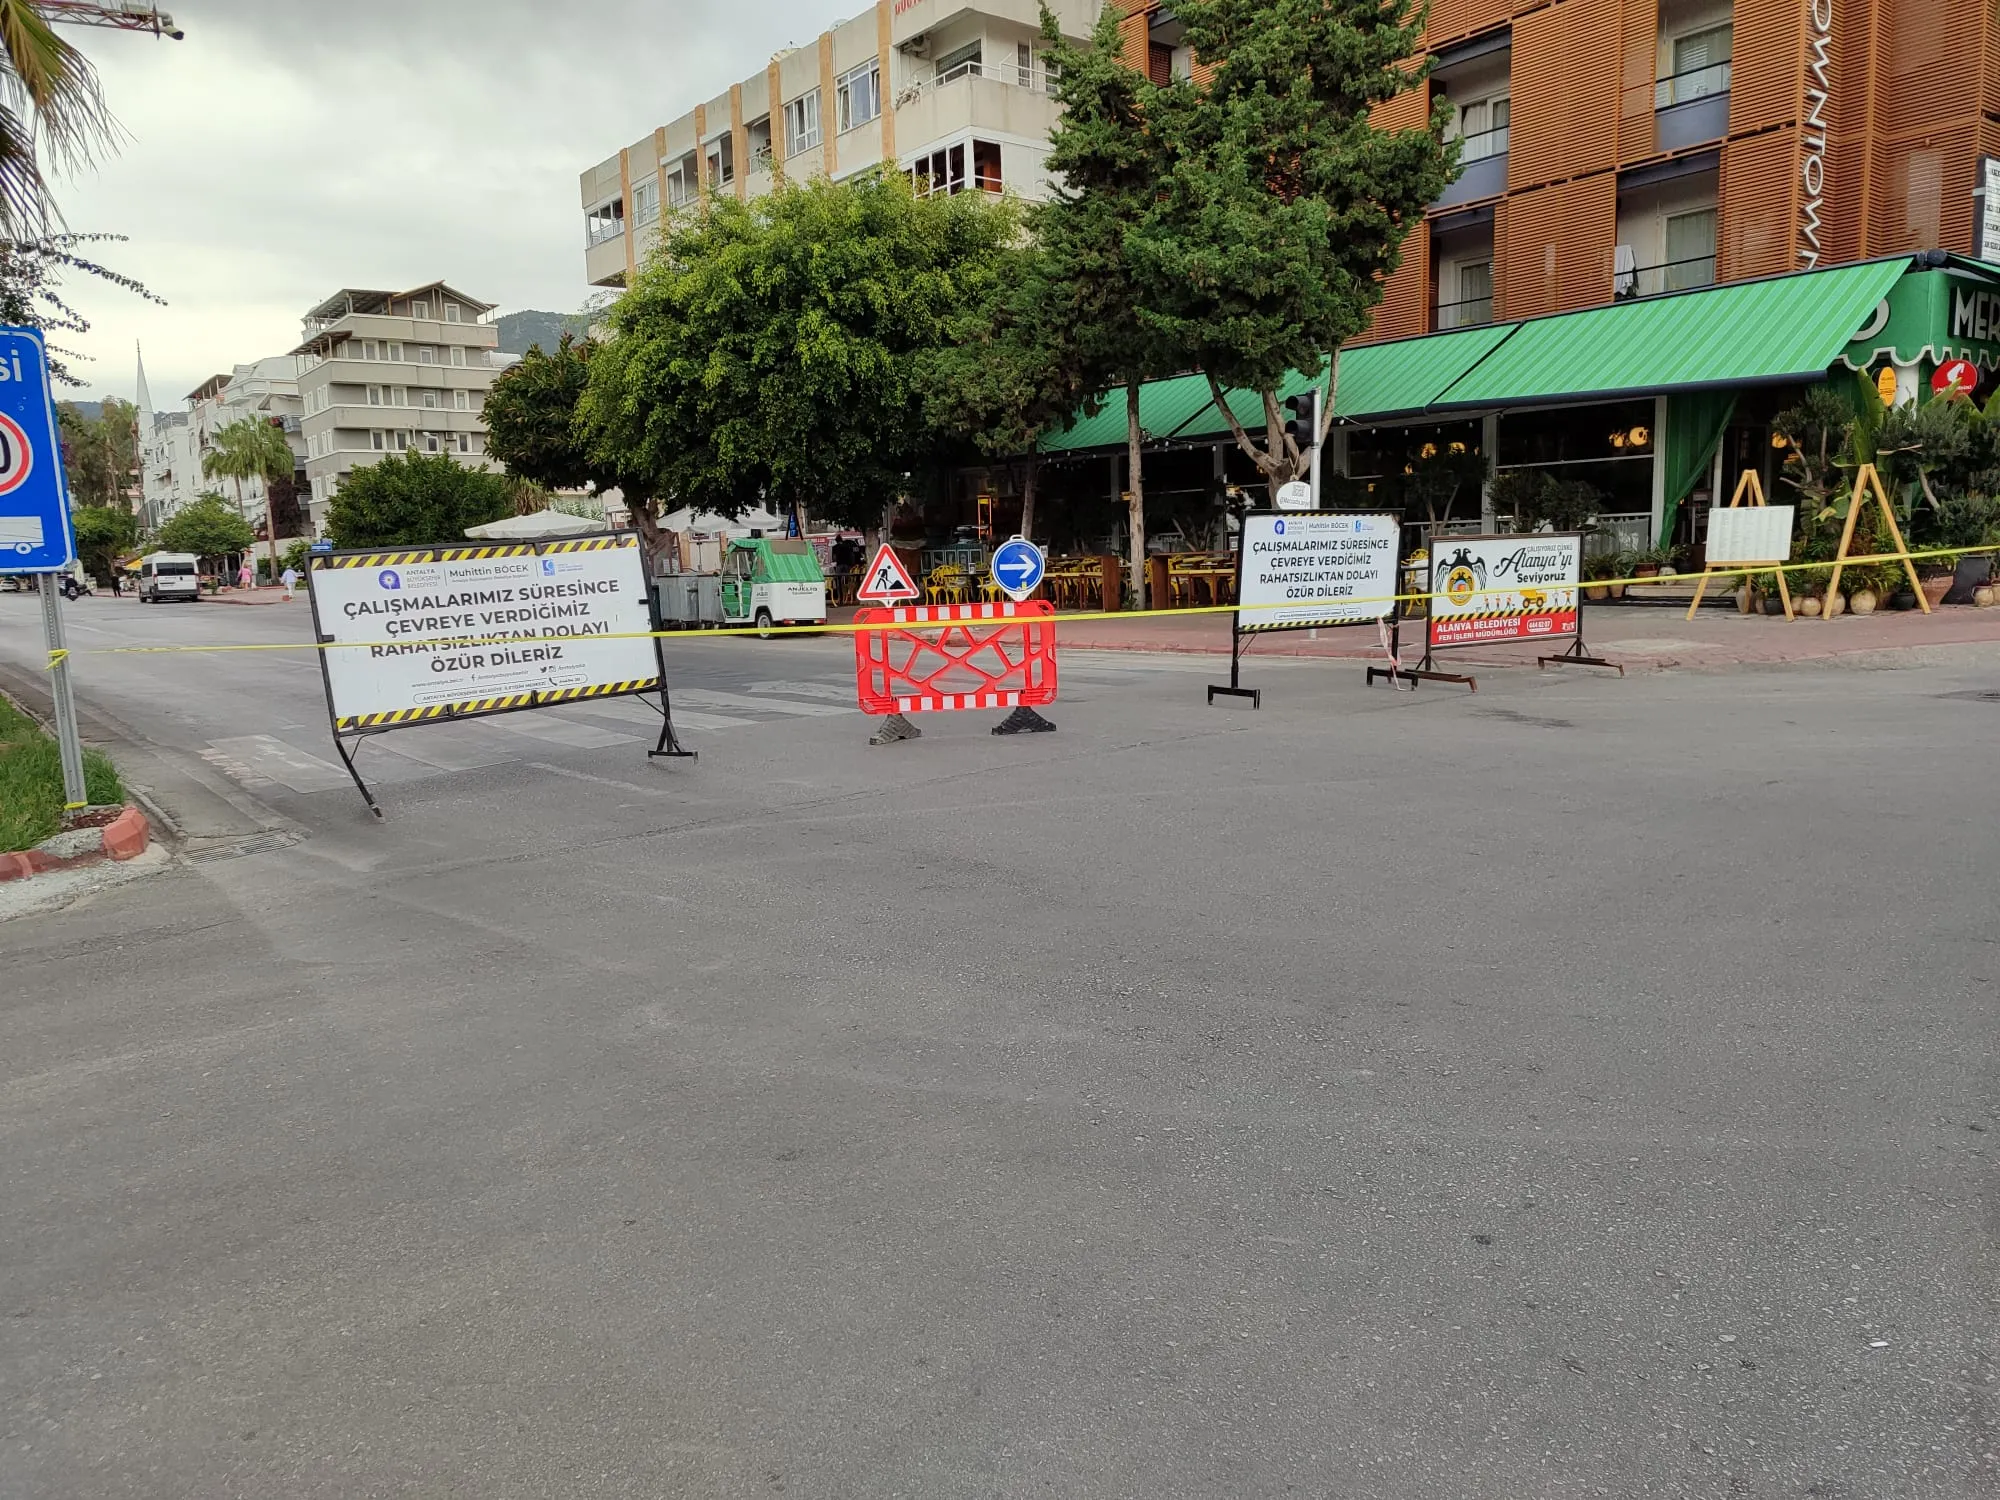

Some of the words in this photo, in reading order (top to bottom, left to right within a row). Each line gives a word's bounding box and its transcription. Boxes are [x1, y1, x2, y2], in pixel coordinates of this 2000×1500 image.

[1252, 540, 1338, 555] ÇALIŞMALARIMIZ
[1340, 537, 1389, 550] SÜRESİNCE
[1270, 556, 1315, 570] ÇEVREYE
[1318, 552, 1371, 566] VERDİĞİMİZ
[1493, 547, 1573, 578] Alanya'yı
[406, 568, 435, 576] ANTALYA
[450, 566, 491, 578] Muhittin
[495, 563, 529, 574] BÖCEK
[1260, 571, 1344, 585] RAHATSIZLIKTAN
[1346, 570, 1378, 581] DOLAYI
[1517, 571, 1566, 584] Seviyoruz
[343, 589, 514, 620] ÇALIŞMALARIMIZ
[519, 579, 620, 600] SÜRESİNCE
[1286, 585, 1314, 599] ÖZÜR
[1317, 583, 1354, 597] DİLERİZ
[385, 614, 475, 637] ÇEVREYE
[480, 600, 590, 625] VERDİĞİMİZ
[1437, 622, 1471, 633] ALANYA
[1473, 617, 1520, 630] BELEDİYESİ
[371, 629, 536, 658] RAHATSIZLIKTAN
[542, 620, 609, 638] DOLAYI
[1453, 632, 1474, 640] İŞLERİ
[431, 653, 484, 673] ÖZÜR
[490, 645, 563, 666] DİLERİZ
